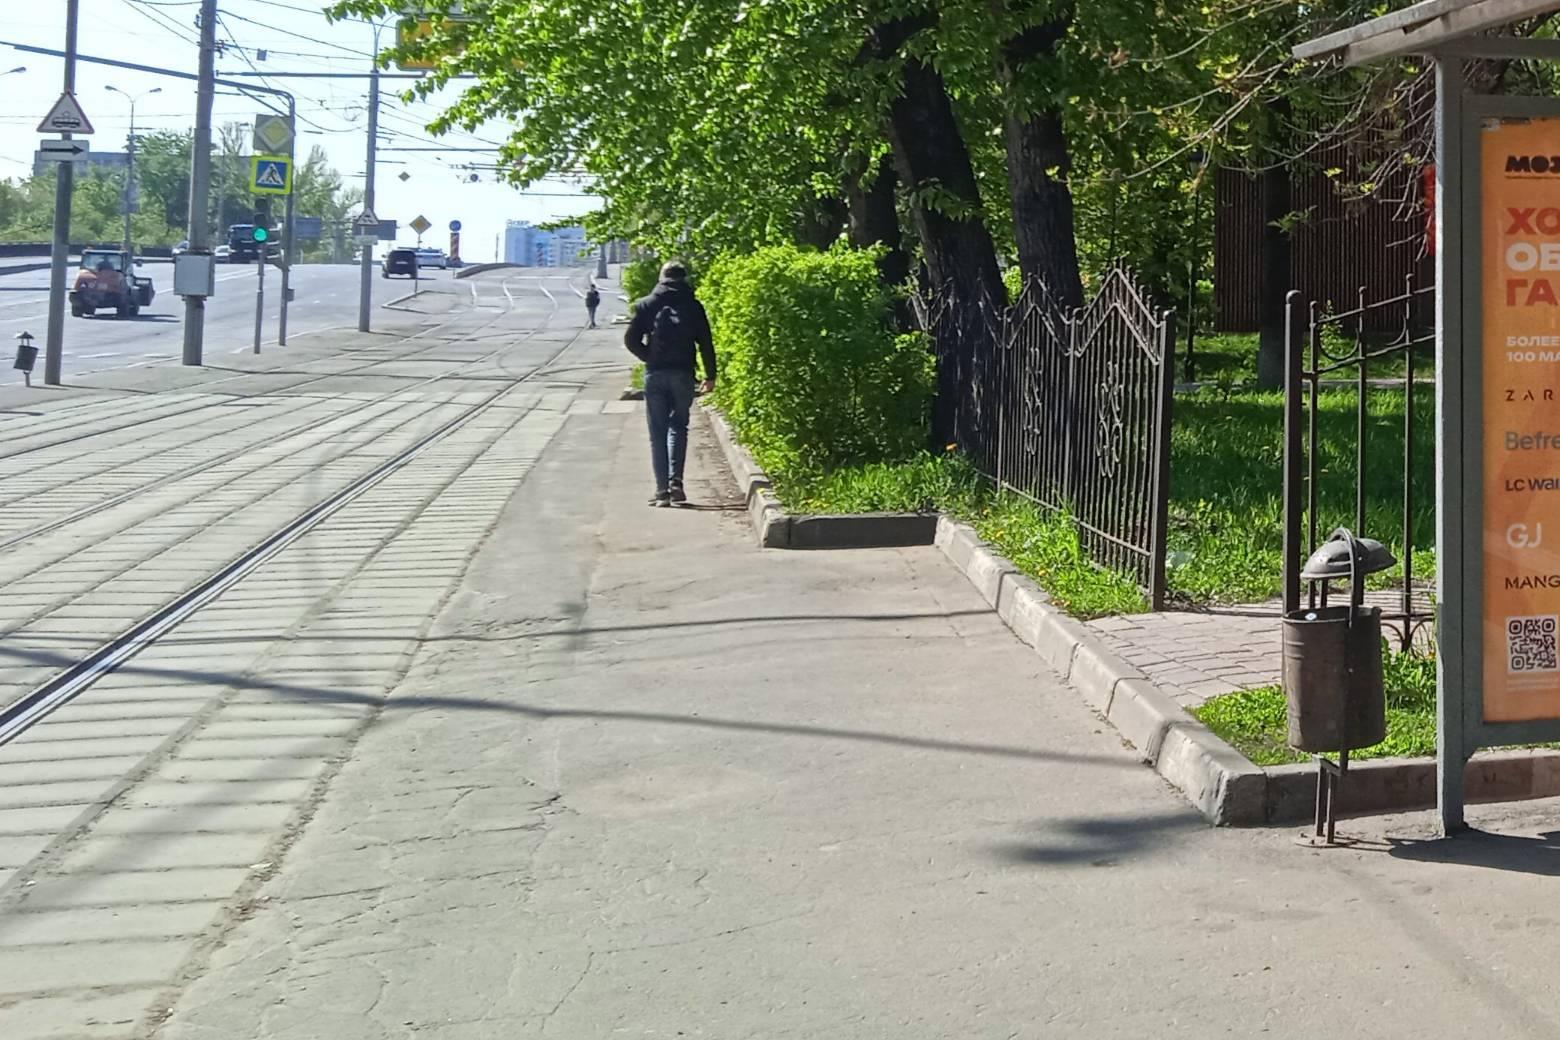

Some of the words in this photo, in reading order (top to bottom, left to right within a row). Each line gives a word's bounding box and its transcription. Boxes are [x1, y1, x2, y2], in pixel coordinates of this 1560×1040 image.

[1506, 336, 1560, 347] БОЛЕЕ
[1506, 351, 1536, 362] 100
[1505, 479, 1525, 492] LC
[1506, 523, 1542, 548] GJ
